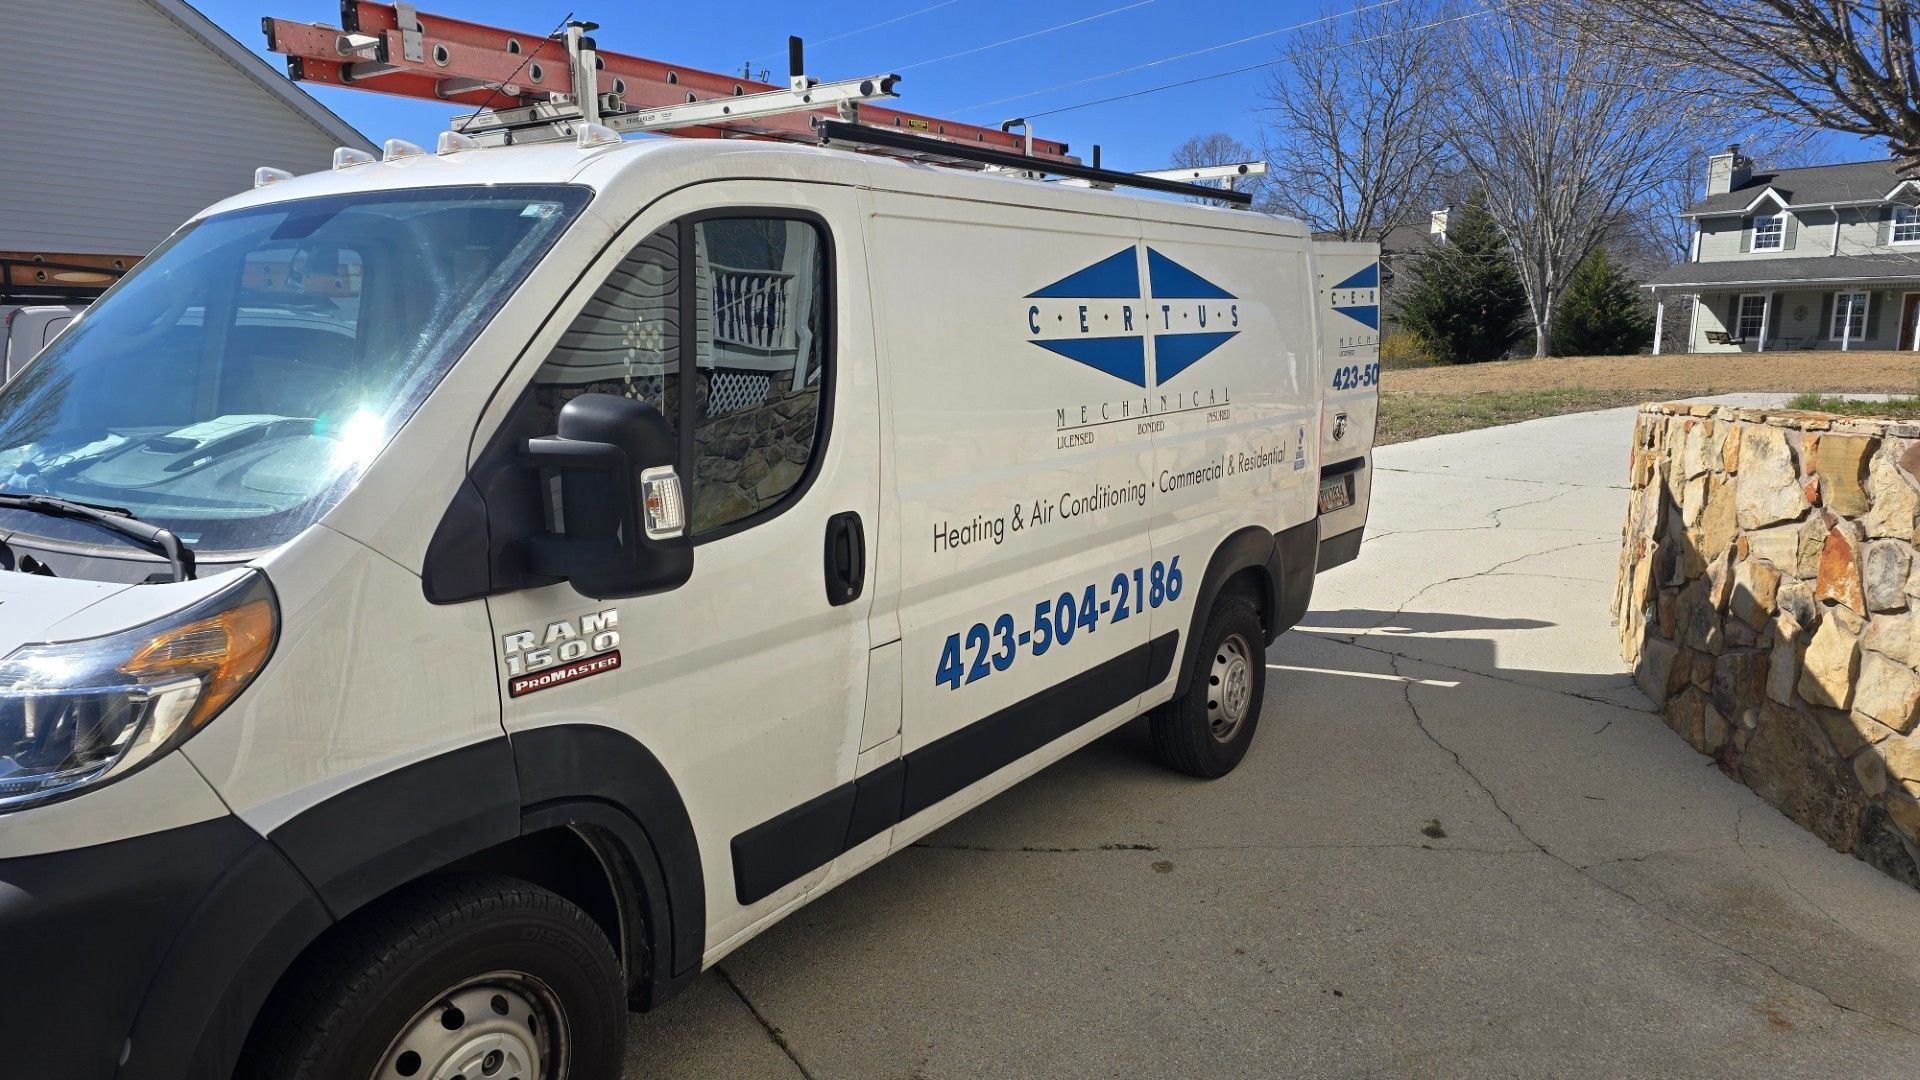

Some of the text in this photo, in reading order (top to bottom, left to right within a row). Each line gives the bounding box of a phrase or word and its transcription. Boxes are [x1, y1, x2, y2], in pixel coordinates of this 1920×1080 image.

[1057, 387, 1230, 427] MECHANICAL
[1057, 409, 1231, 450] LICENSED BONDED INSURED
[933, 514, 1004, 553] Heating
[1011, 503, 1024, 532] &
[1030, 499, 1054, 528] Air
[1059, 483, 1146, 519] Conditioning
[1159, 455, 1225, 493] Commercial
[1227, 454, 1235, 476] &
[1238, 440, 1286, 473] Residential
[502, 608, 618, 656] RAM
[935, 554, 1183, 691] 423-504-2186
[505, 630, 620, 676] 1500
